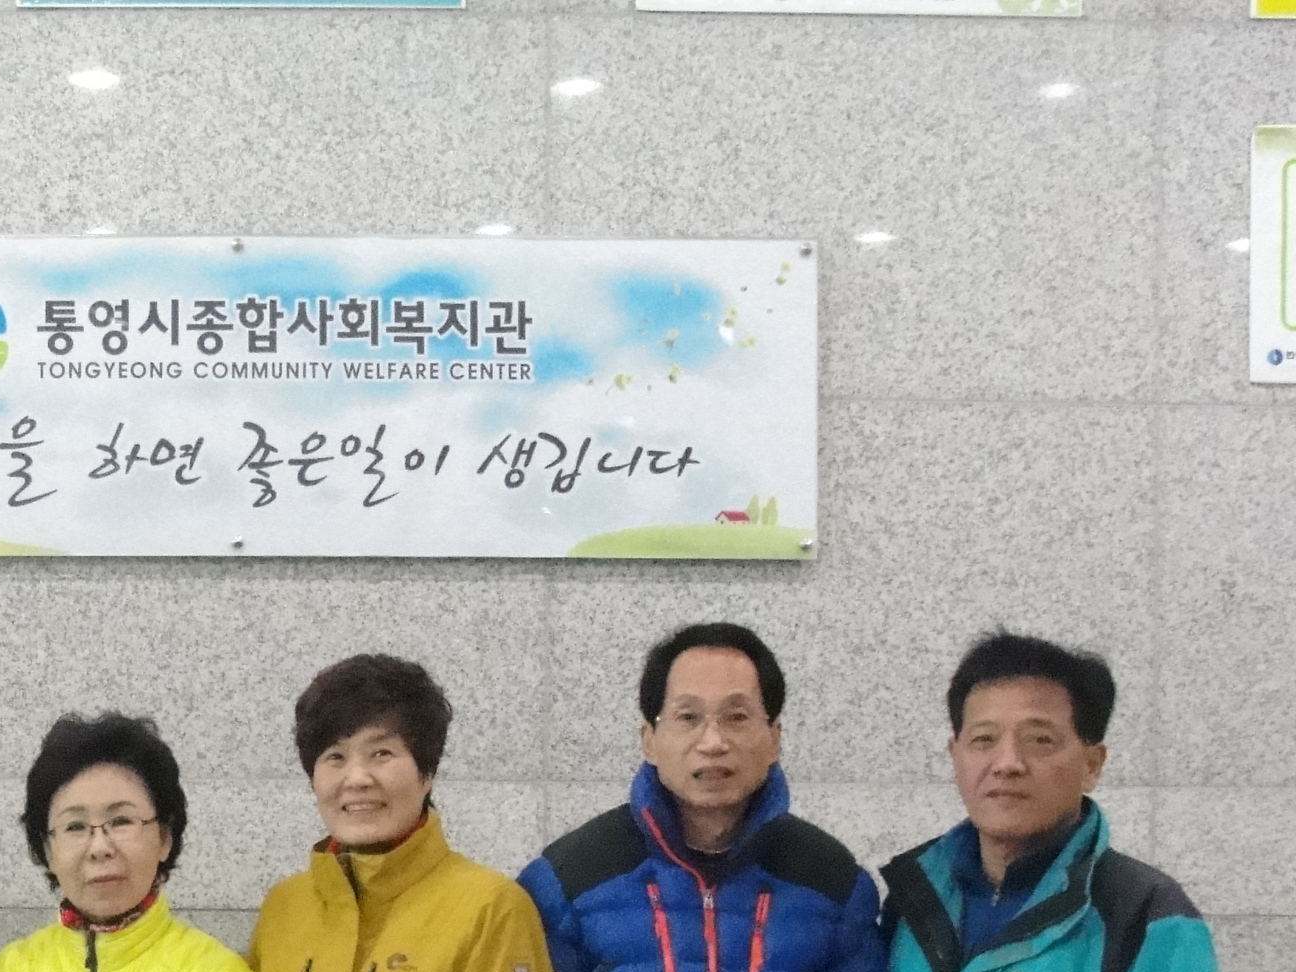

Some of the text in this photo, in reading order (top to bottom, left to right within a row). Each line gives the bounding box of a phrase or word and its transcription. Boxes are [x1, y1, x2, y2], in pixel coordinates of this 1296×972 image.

[36, 297, 534, 356] 통영시종합사회복지관
[37, 361, 533, 381] TONGYEONG COMMUNITY WELFARE CENTER
[88, 422, 205, 486] 하면
[476, 431, 701, 494] 생깁니다
